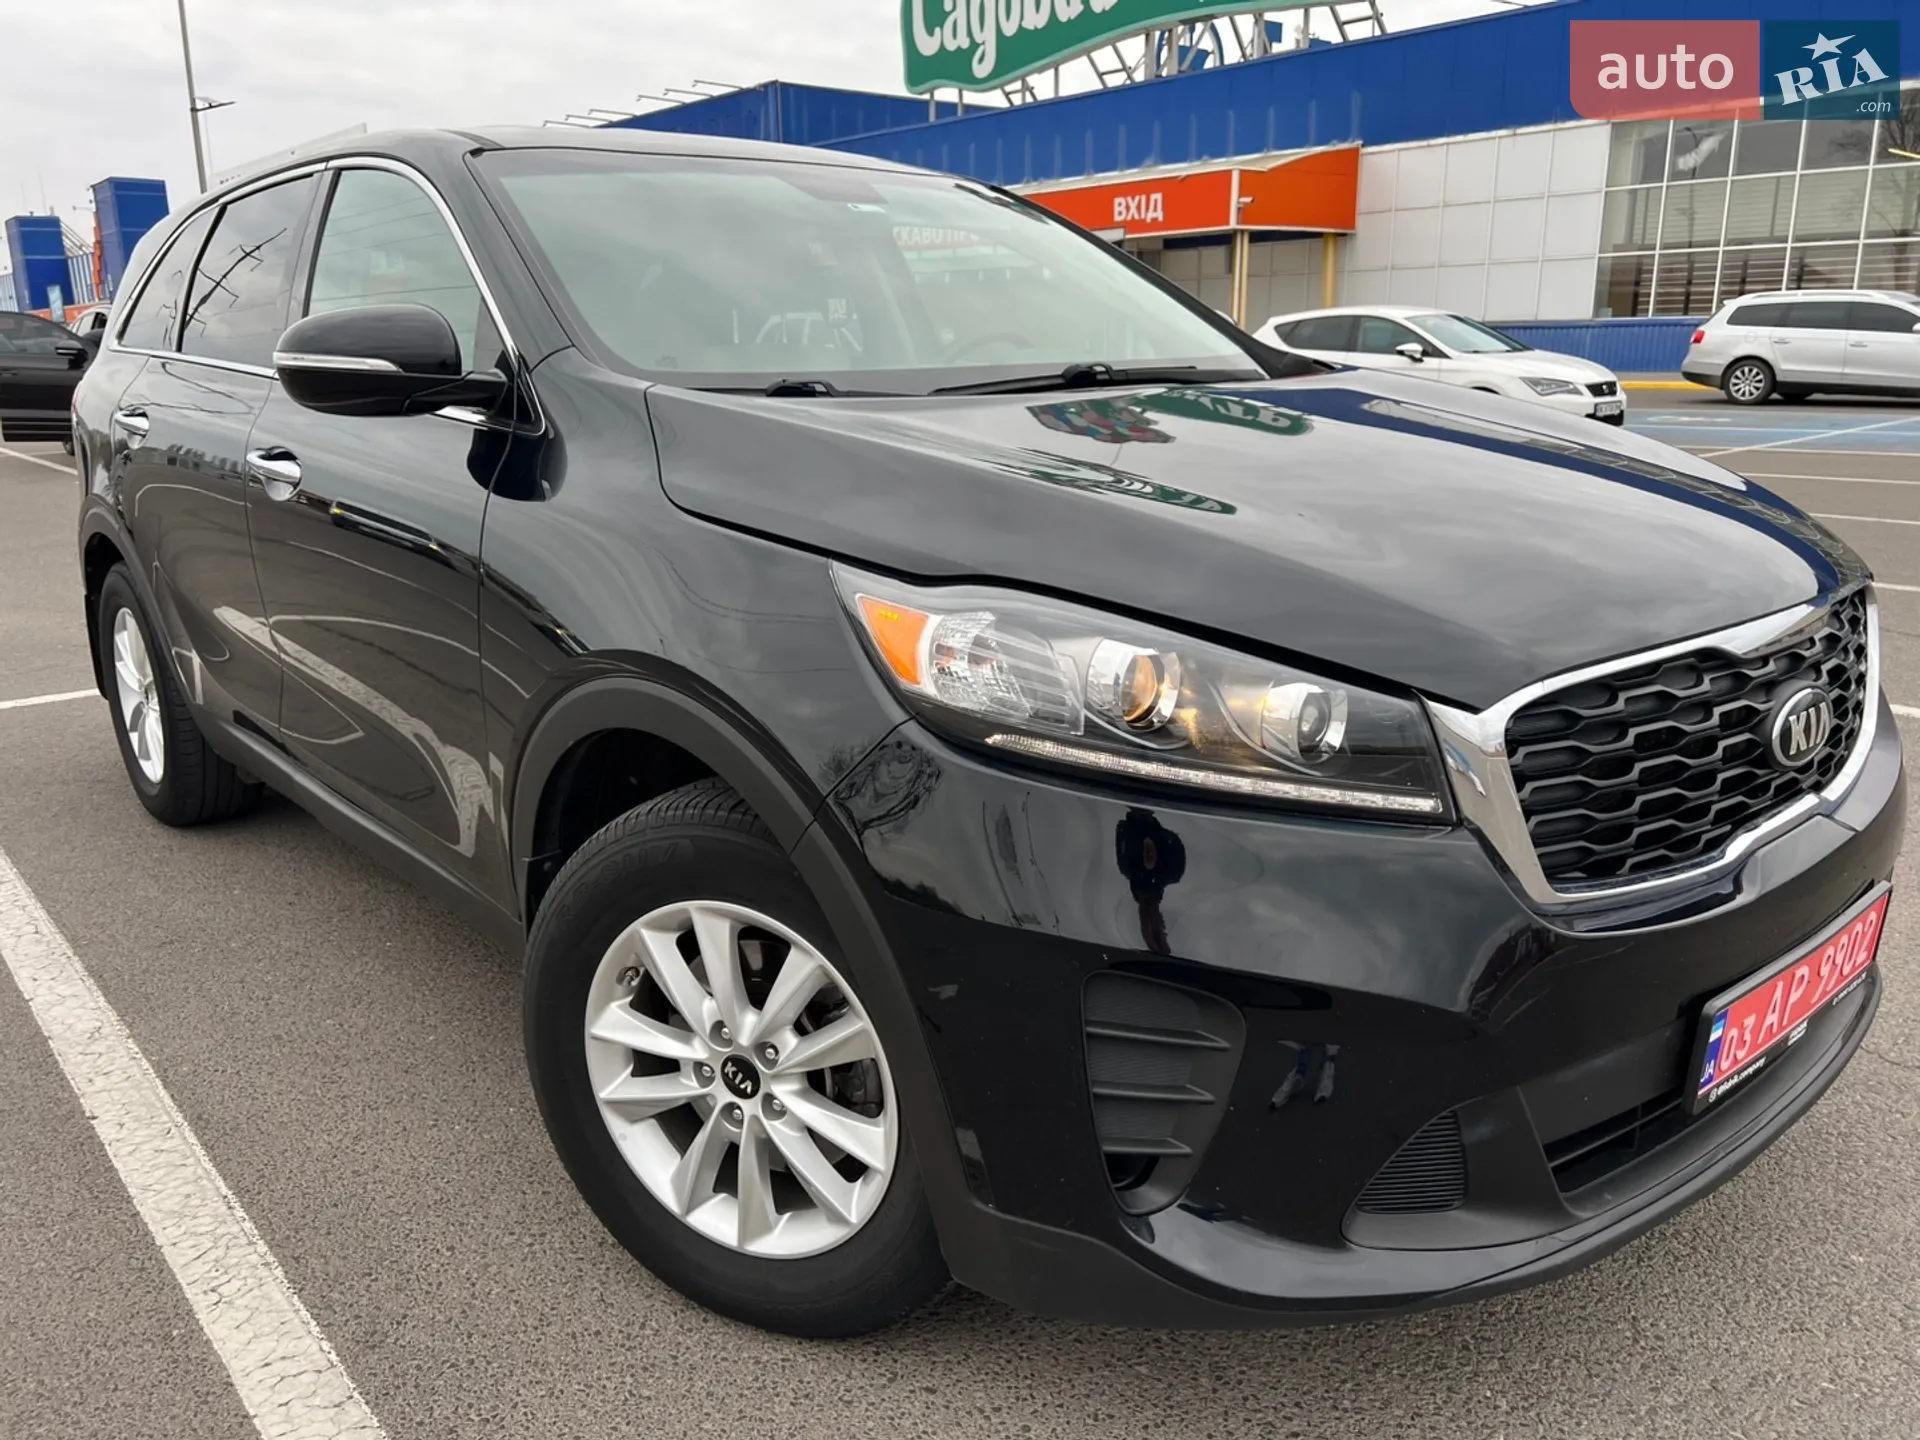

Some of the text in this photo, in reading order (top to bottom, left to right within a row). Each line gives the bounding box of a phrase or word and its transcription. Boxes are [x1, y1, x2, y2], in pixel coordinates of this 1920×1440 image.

[1113, 192, 1163, 223] ВХІД
[1719, 1013, 1756, 1071] 03
[1811, 911, 1877, 1004] 9902
[724, 1061, 752, 1095] KIA
